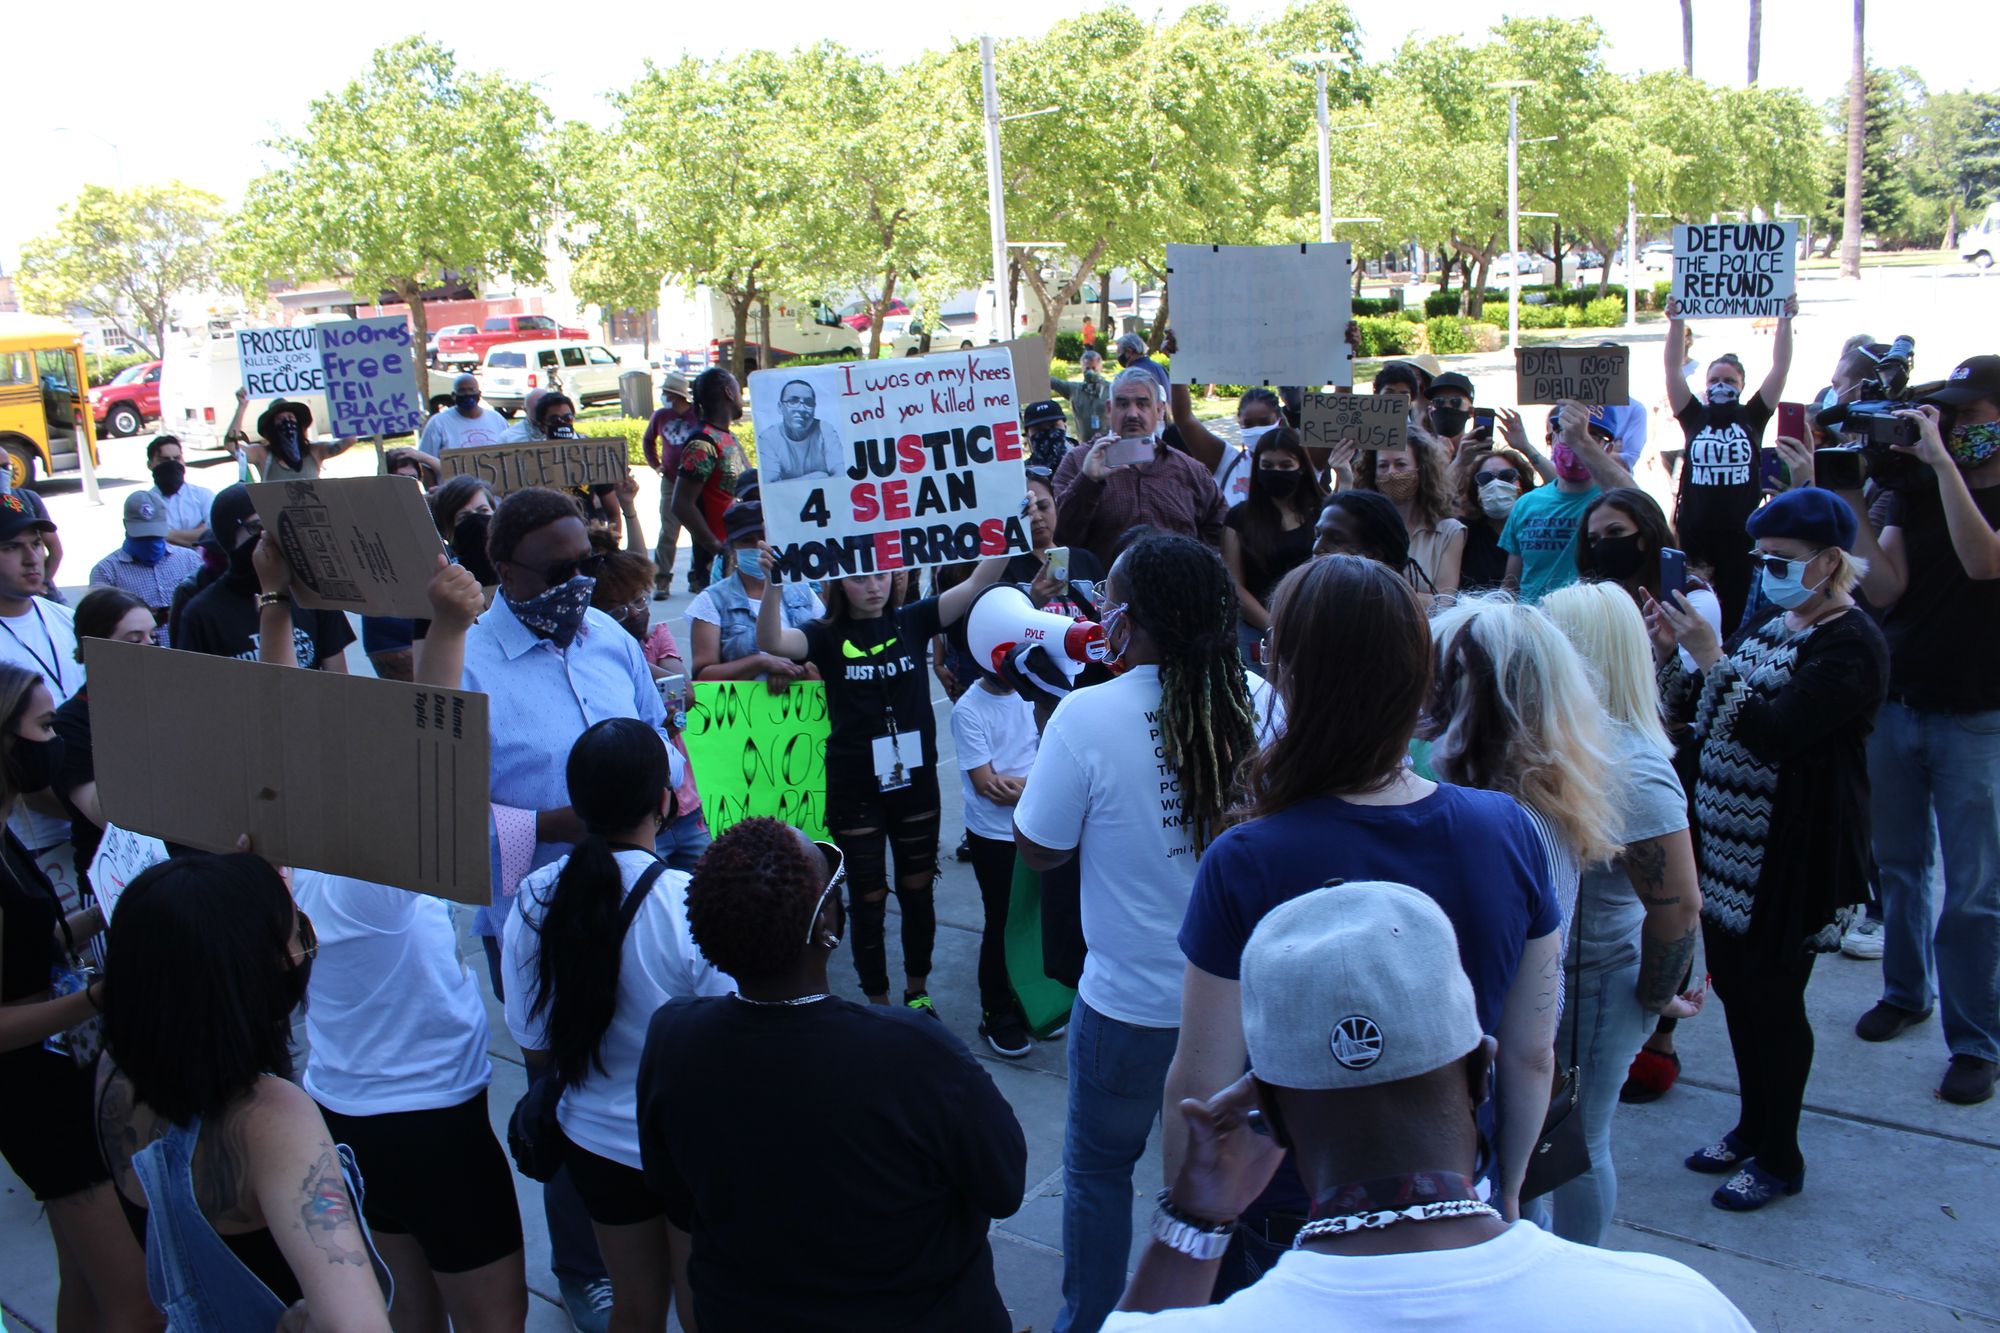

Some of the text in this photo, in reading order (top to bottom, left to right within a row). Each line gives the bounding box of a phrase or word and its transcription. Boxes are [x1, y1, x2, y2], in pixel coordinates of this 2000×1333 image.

[1687, 224, 1785, 252] DEFUND
[1675, 252, 1784, 274] THE POLICE
[1684, 273, 1774, 298] REFUND
[1675, 298, 1702, 316] OUR
[240, 328, 317, 356] PROSECUT
[244, 352, 312, 367] KILLER COPS
[321, 353, 403, 379] Free
[1522, 350, 1626, 376] DA NOT
[247, 369, 325, 395] RECUSE
[839, 354, 1011, 396] I was on my Knees
[1303, 394, 1404, 414] PROSECUTE
[1534, 378, 1610, 405] DELAY
[335, 393, 410, 421] BLACK
[850, 387, 1010, 424] and you Killed me
[1336, 412, 1363, 425] OR
[1303, 420, 1400, 446] RECUSE
[847, 421, 1022, 480] JUSTICE
[1694, 442, 1750, 463] LIVES
[1691, 465, 1750, 485] MATTER
[800, 470, 978, 528] 4 SEAN
[769, 516, 1033, 584] MONTERROSA
[1025, 628, 1045, 640] PYLE
[844, 665, 875, 680] JUST
[413, 692, 428, 729] Topic:
[432, 693, 446, 730] Date:
[452, 696, 465, 739] Name:
[691, 683, 752, 735] SIN
